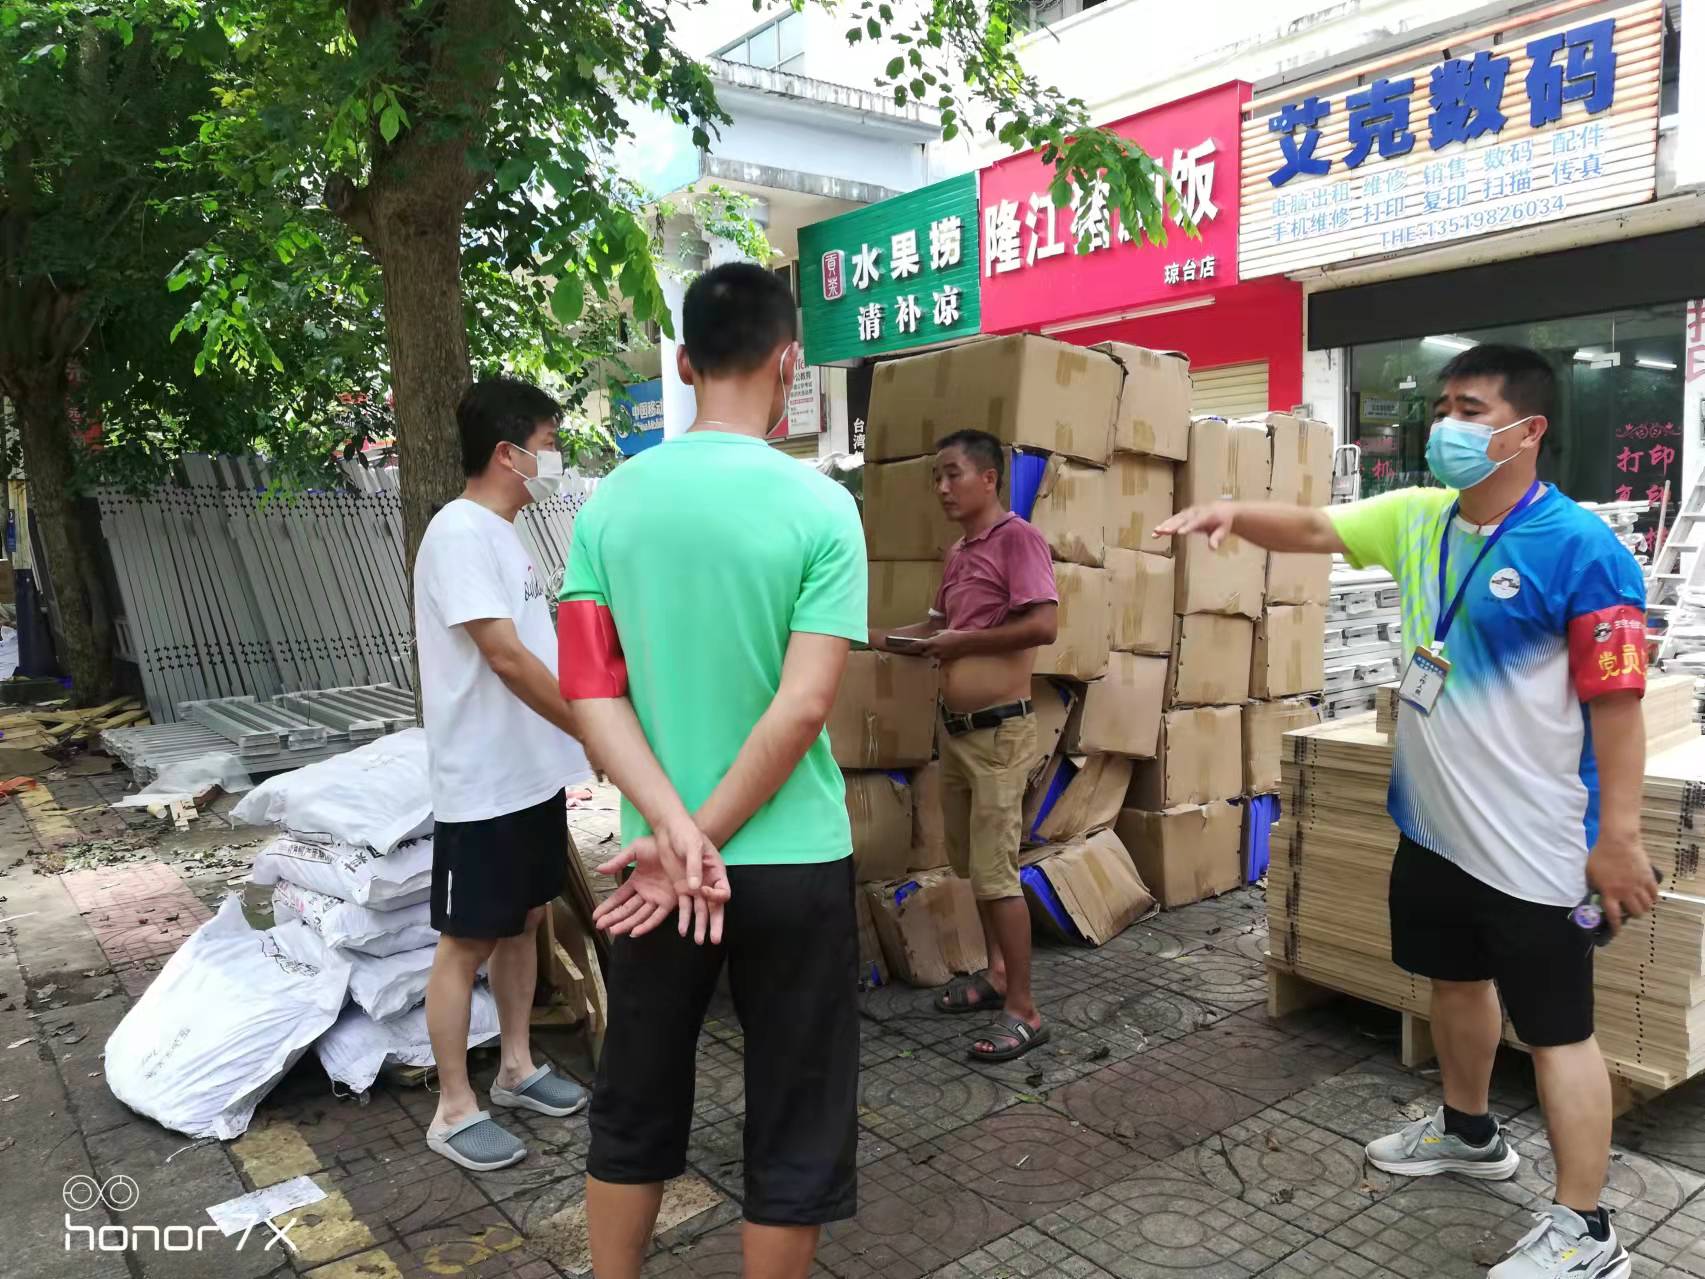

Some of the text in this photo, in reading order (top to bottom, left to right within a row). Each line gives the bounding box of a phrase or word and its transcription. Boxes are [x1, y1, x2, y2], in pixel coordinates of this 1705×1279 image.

[1268, 18, 1616, 188] 艾克数码
[1272, 125, 1604, 217] 电脑出租 维修 销售 数码 配件
[1274, 153, 1603, 241] 手机维修 打印 复印 扫描 传真
[851, 216, 963, 291] 水果捞
[1164, 256, 1216, 285] 琼台店
[857, 285, 960, 341] 清补凉
[1616, 444, 1675, 476] 打印
[1598, 643, 1648, 681] 党员
